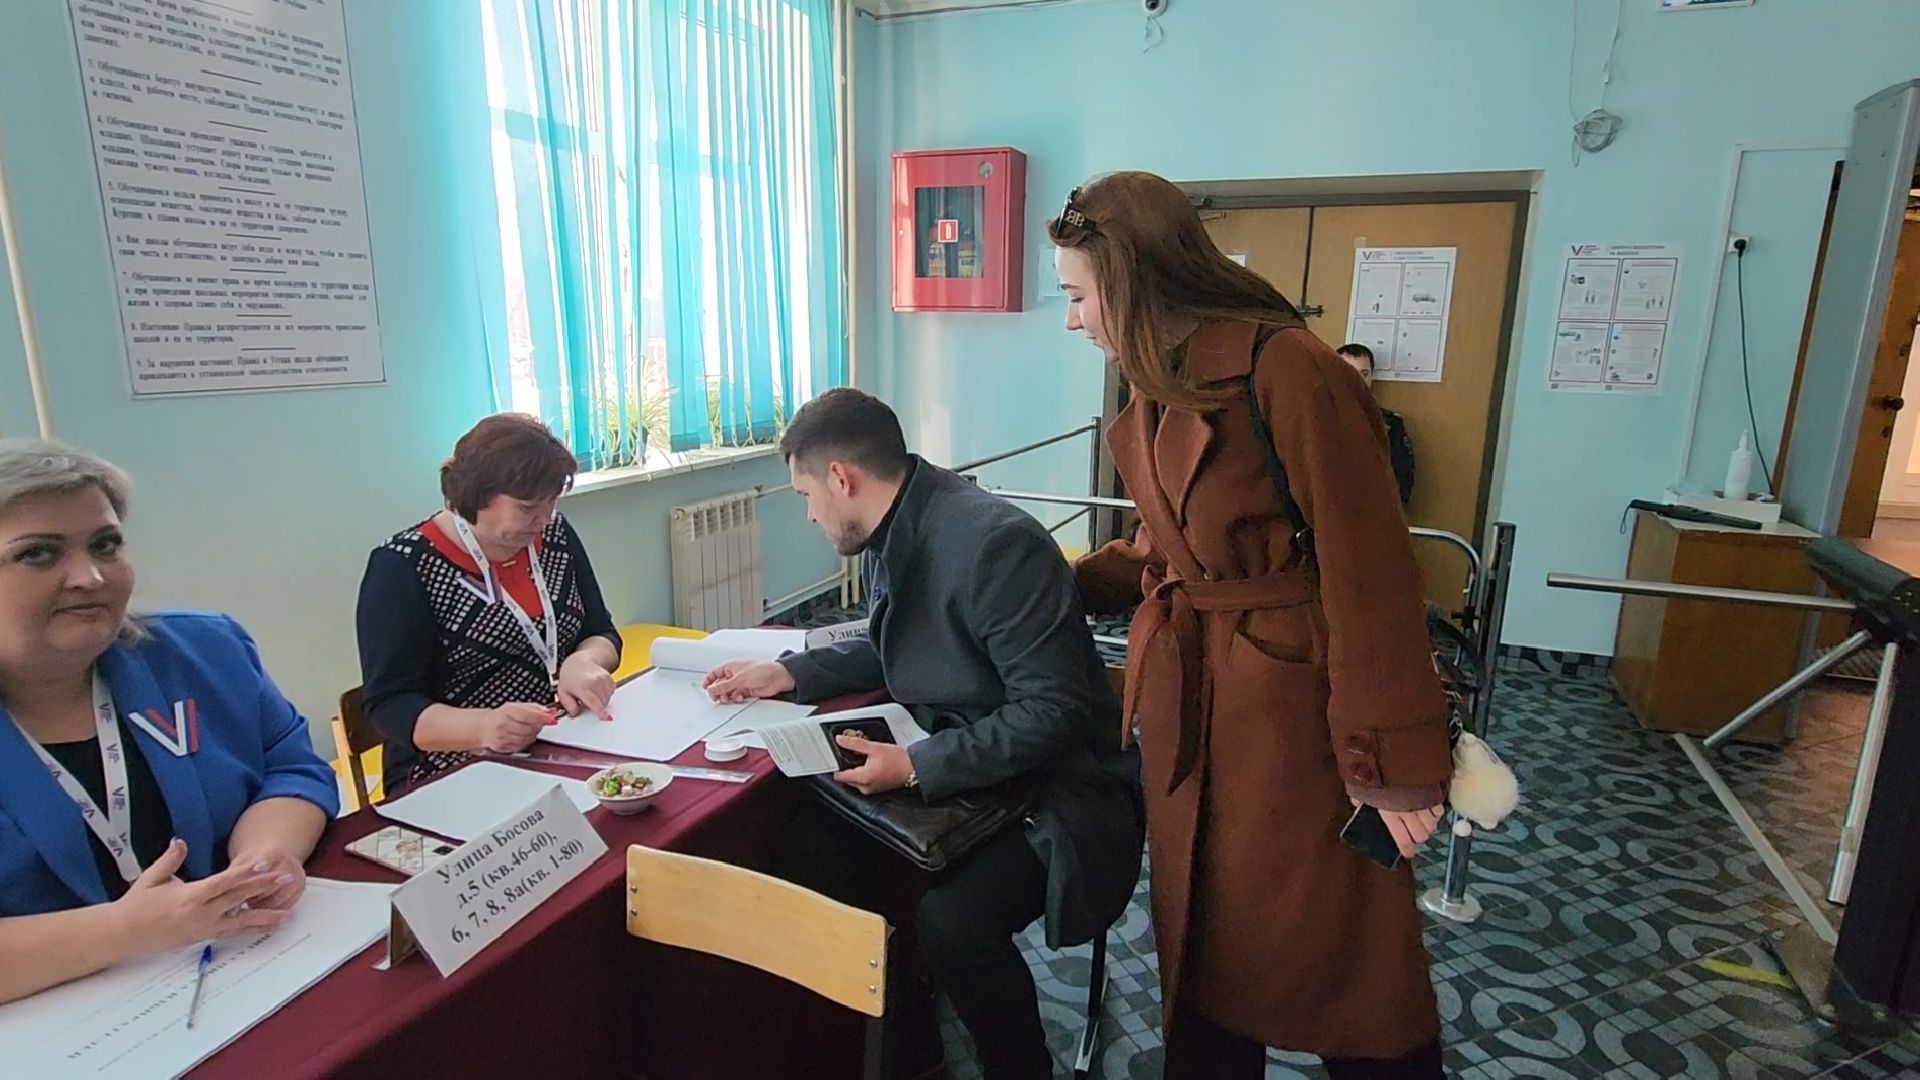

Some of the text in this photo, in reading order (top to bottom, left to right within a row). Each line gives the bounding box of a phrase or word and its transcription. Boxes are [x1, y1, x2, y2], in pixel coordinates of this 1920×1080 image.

[435, 809, 545, 884] Улица Босова
[456, 831, 558, 910] д.5 (кв.46-60),
[451, 838, 584, 944] 6, 7, 8, 8а(кв. 1-80)
